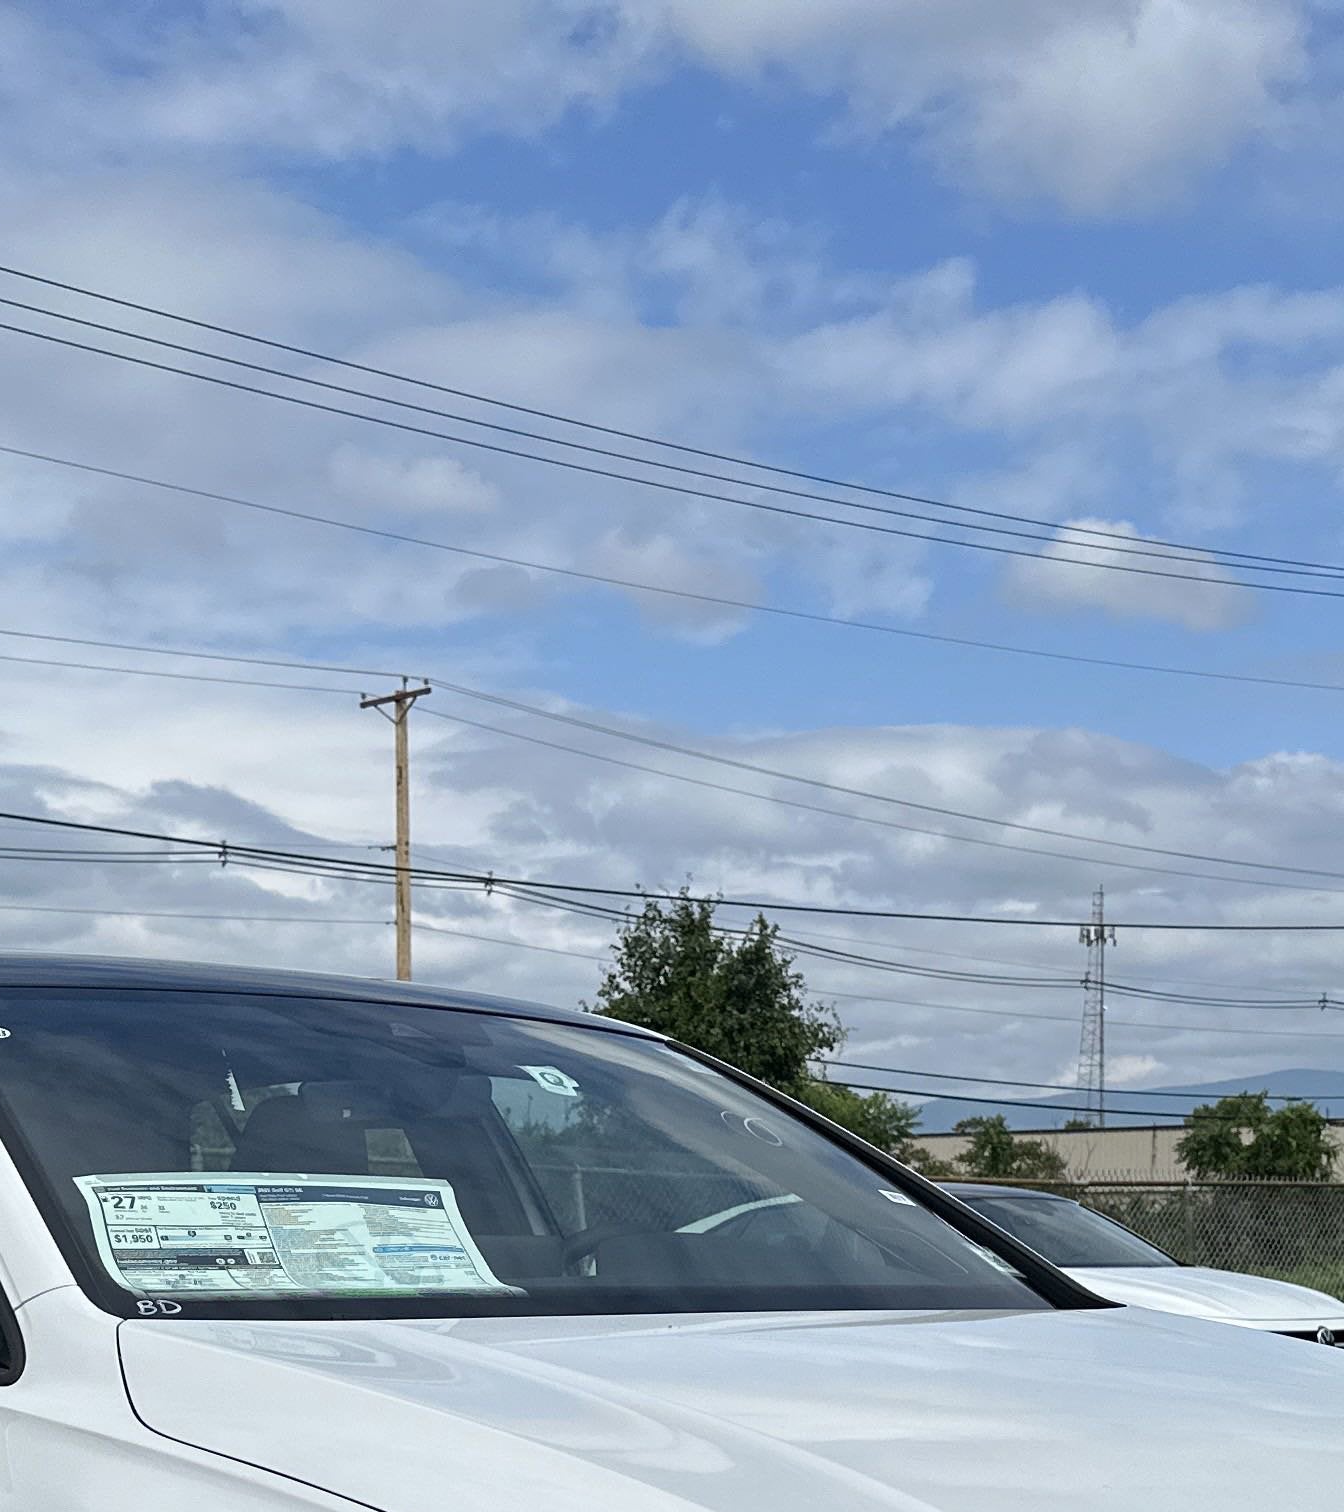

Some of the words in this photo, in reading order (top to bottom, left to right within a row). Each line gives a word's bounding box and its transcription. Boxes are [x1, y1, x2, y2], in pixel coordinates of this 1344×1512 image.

[111, 1196, 136, 1209] 27
[210, 1201, 237, 1211] $250
[114, 1234, 154, 1244] $1,950
[136, 1299, 182, 1316] BD
